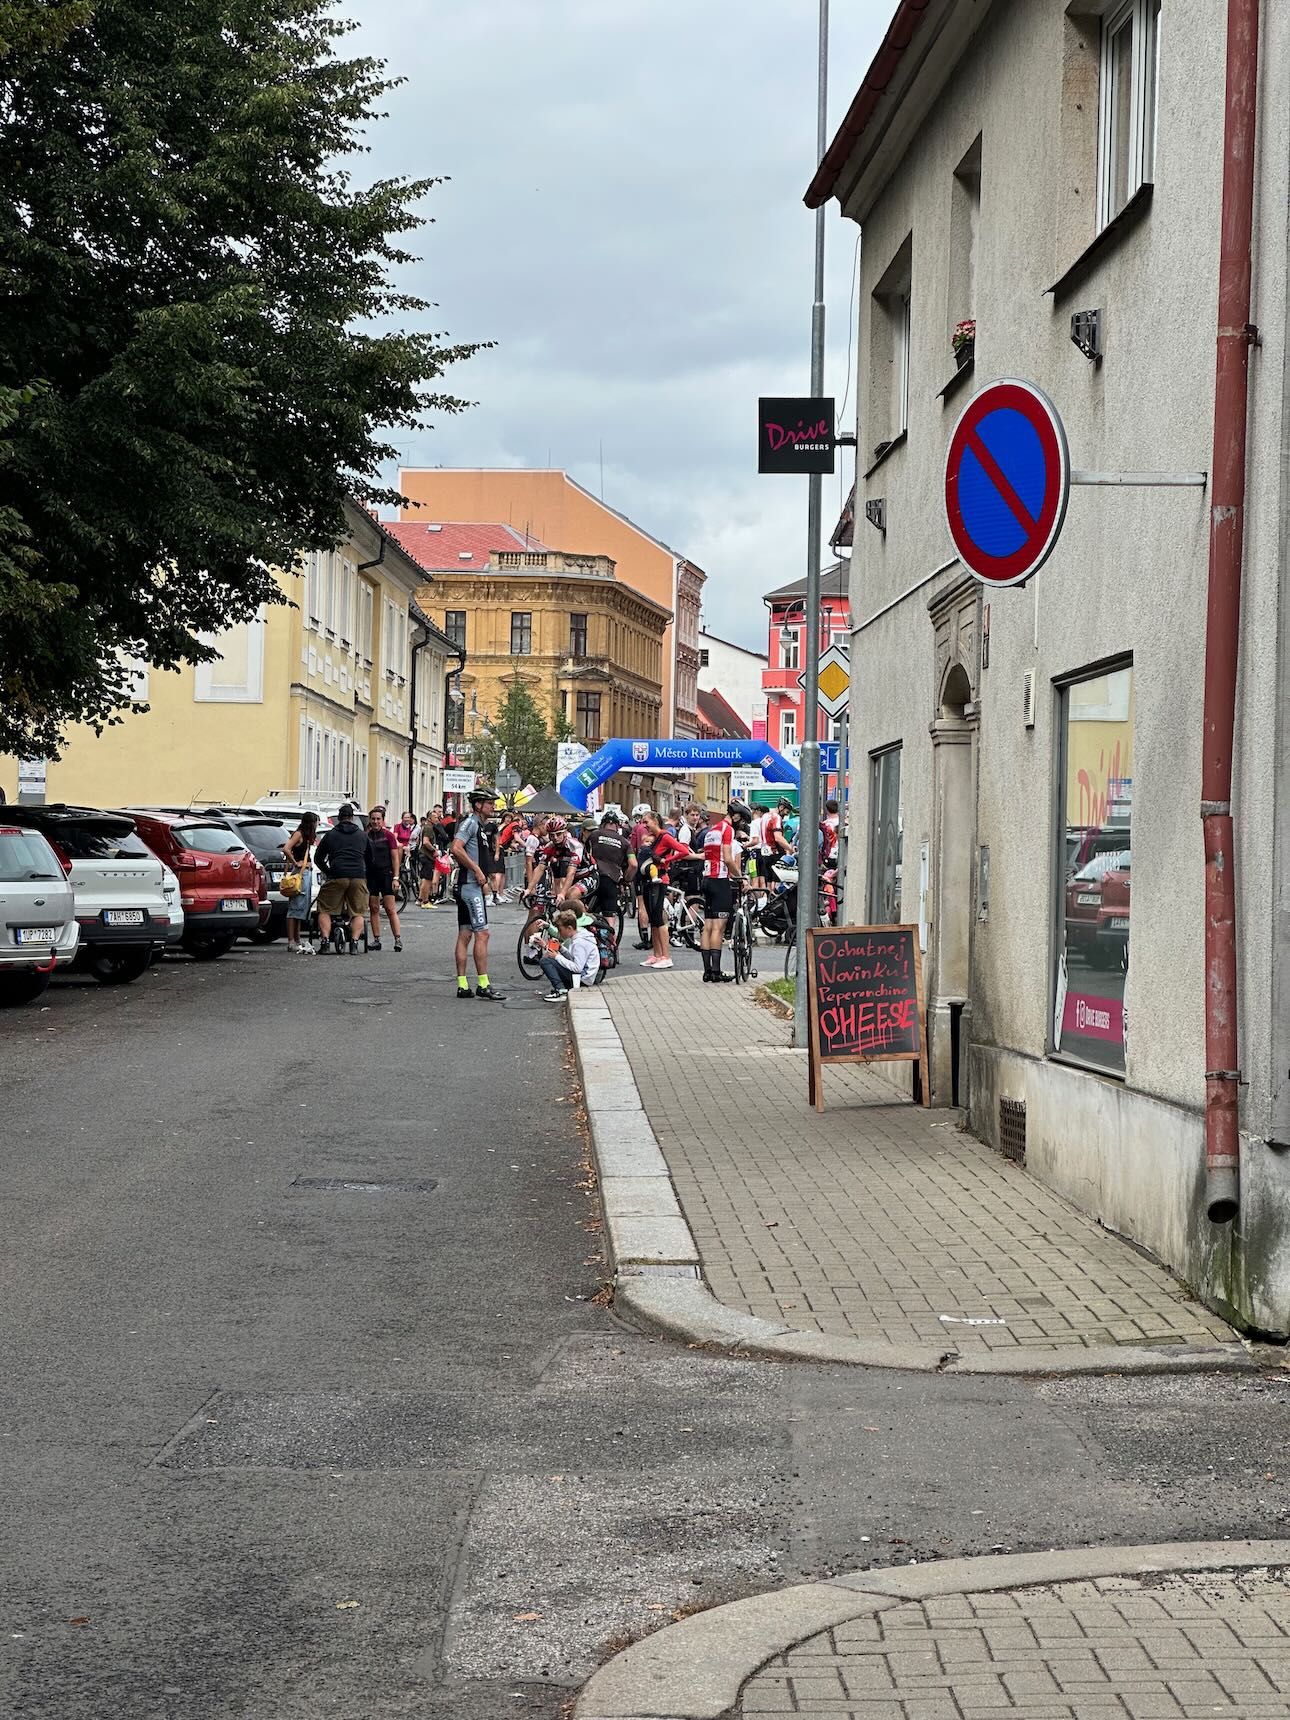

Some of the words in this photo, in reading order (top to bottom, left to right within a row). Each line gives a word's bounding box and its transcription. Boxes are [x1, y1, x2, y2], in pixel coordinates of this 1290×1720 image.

[765, 420, 828, 450] Drive
[655, 746, 688, 759] Město
[691, 747, 742, 759] Rumburk
[473, 896, 485, 924] CYKLO
[817, 936, 908, 961] Ochutnej
[820, 960, 909, 985] Novinku!
[820, 998, 916, 1040] CHEESE
